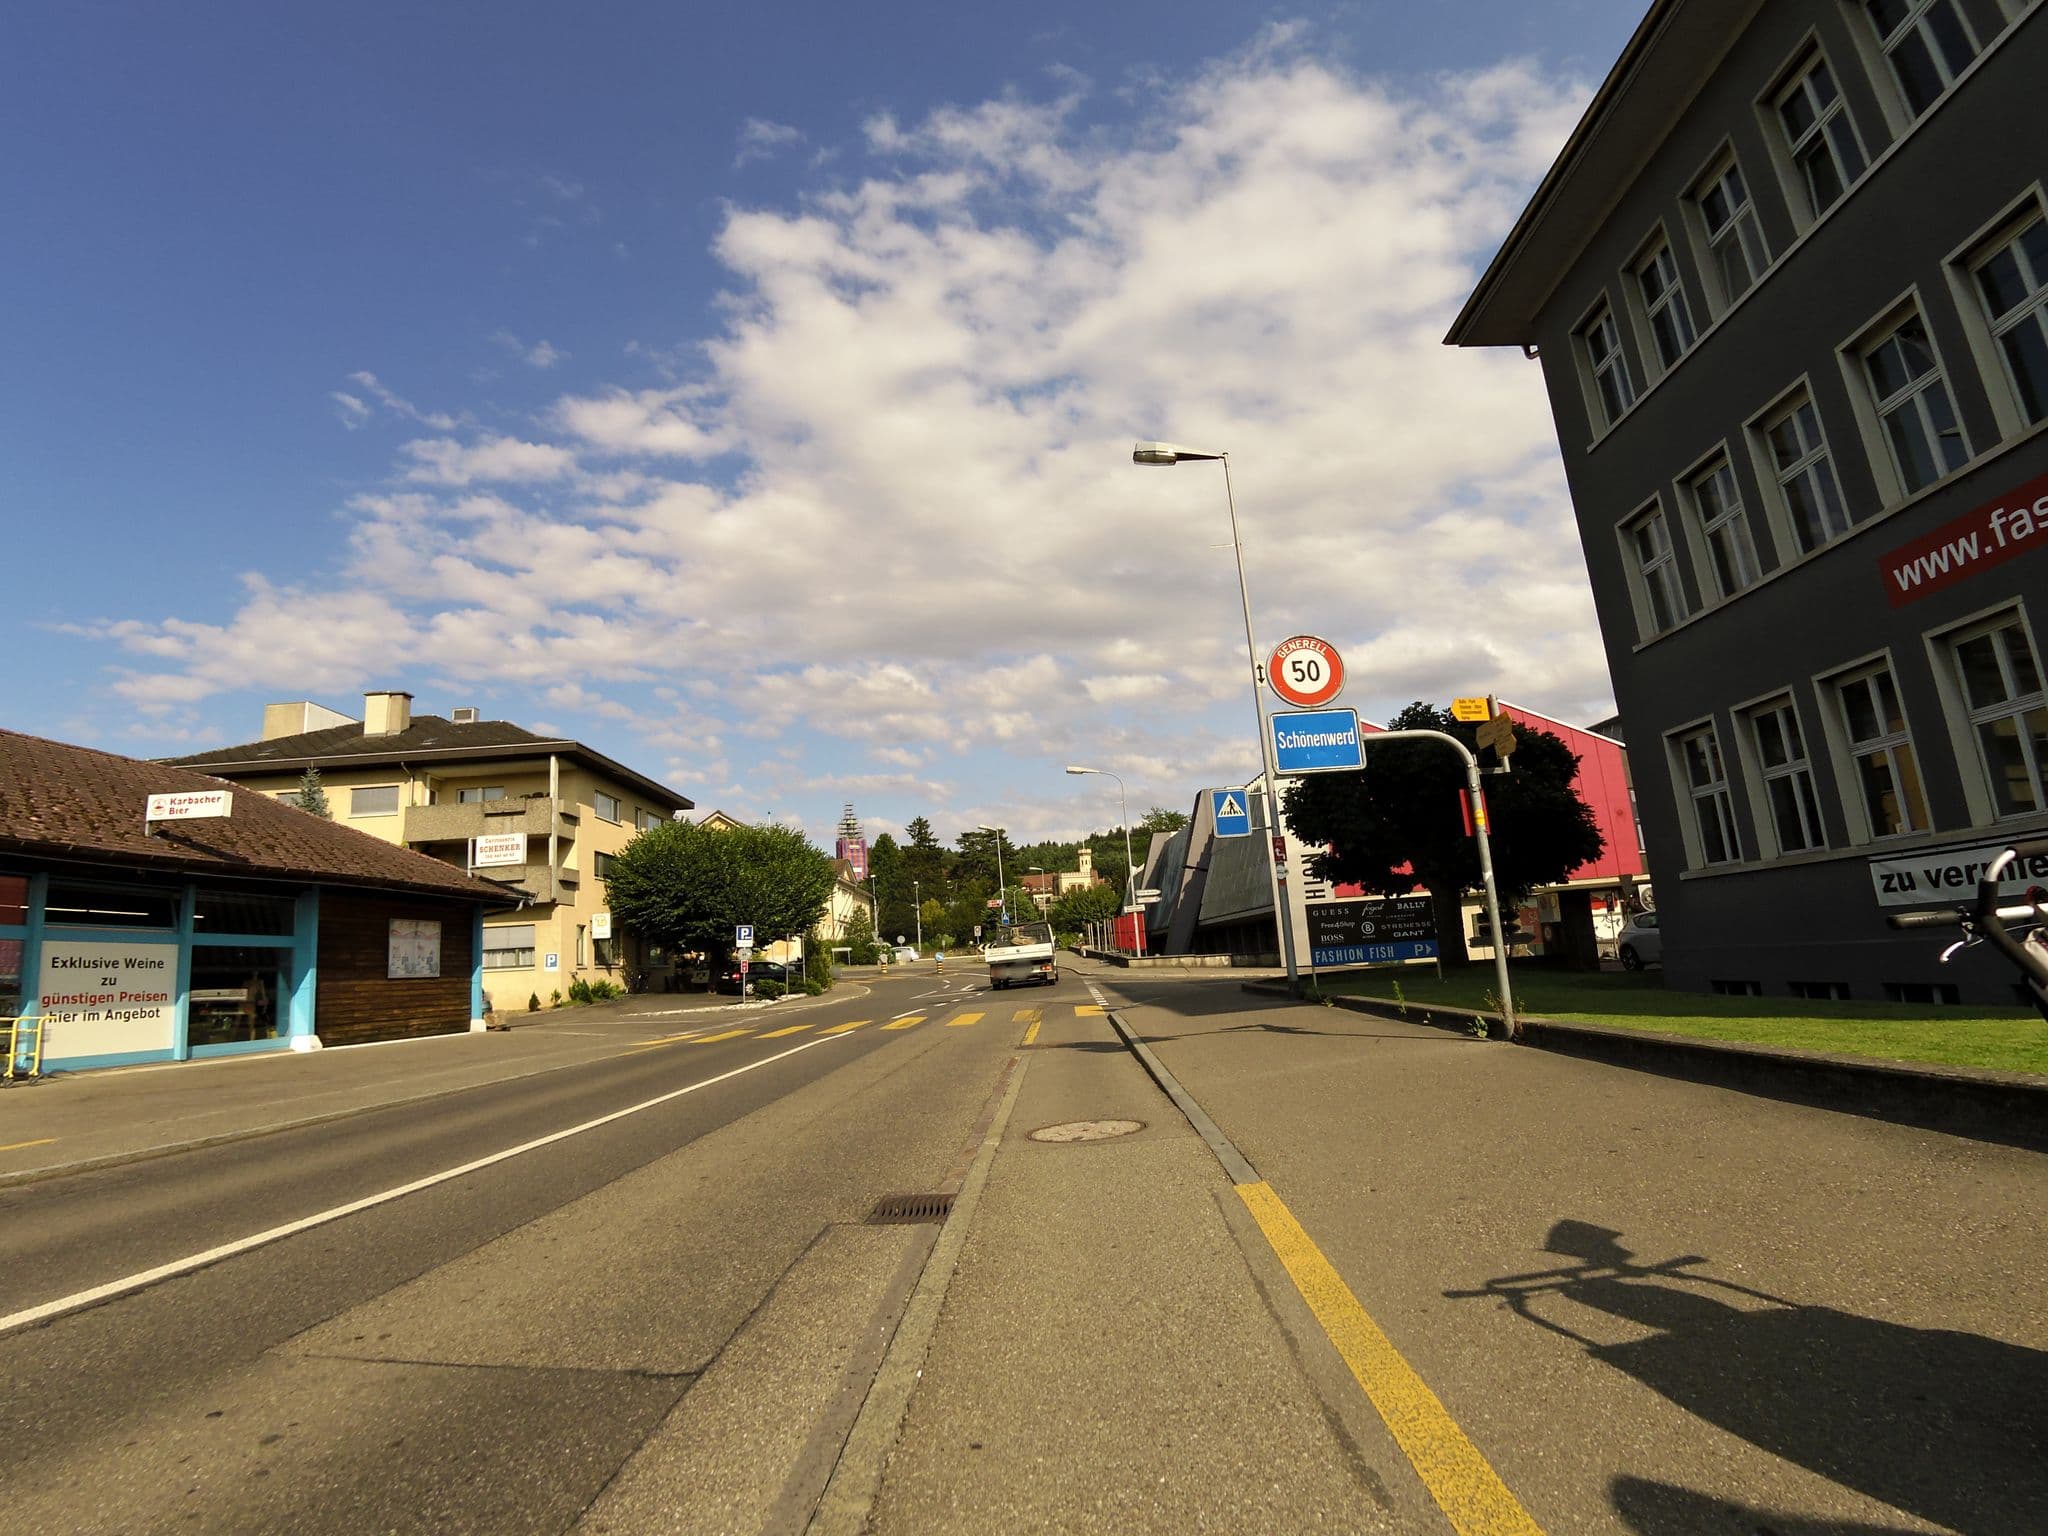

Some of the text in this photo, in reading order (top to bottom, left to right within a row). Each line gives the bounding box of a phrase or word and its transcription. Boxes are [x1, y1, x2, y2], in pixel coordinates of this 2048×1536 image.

[1277, 639, 1327, 659] GENERELL
[1291, 660, 1320, 682] 50
[1278, 728, 1355, 749] Schönenwerd
[168, 807, 189, 815] Bier
[479, 843, 521, 853] SCHENKER
[1880, 870, 1917, 893] zu
[1312, 907, 1350, 917] GUESS
[1397, 901, 1426, 910] BALLY
[1320, 933, 1344, 943] BOSS
[1315, 945, 1394, 963] FASHION FISH
[51, 956, 165, 969] Exklusive Weine
[100, 976, 118, 986] zu
[42, 990, 168, 1008] günstigen Preisen
[49, 1007, 161, 1023] hier im Angebot
